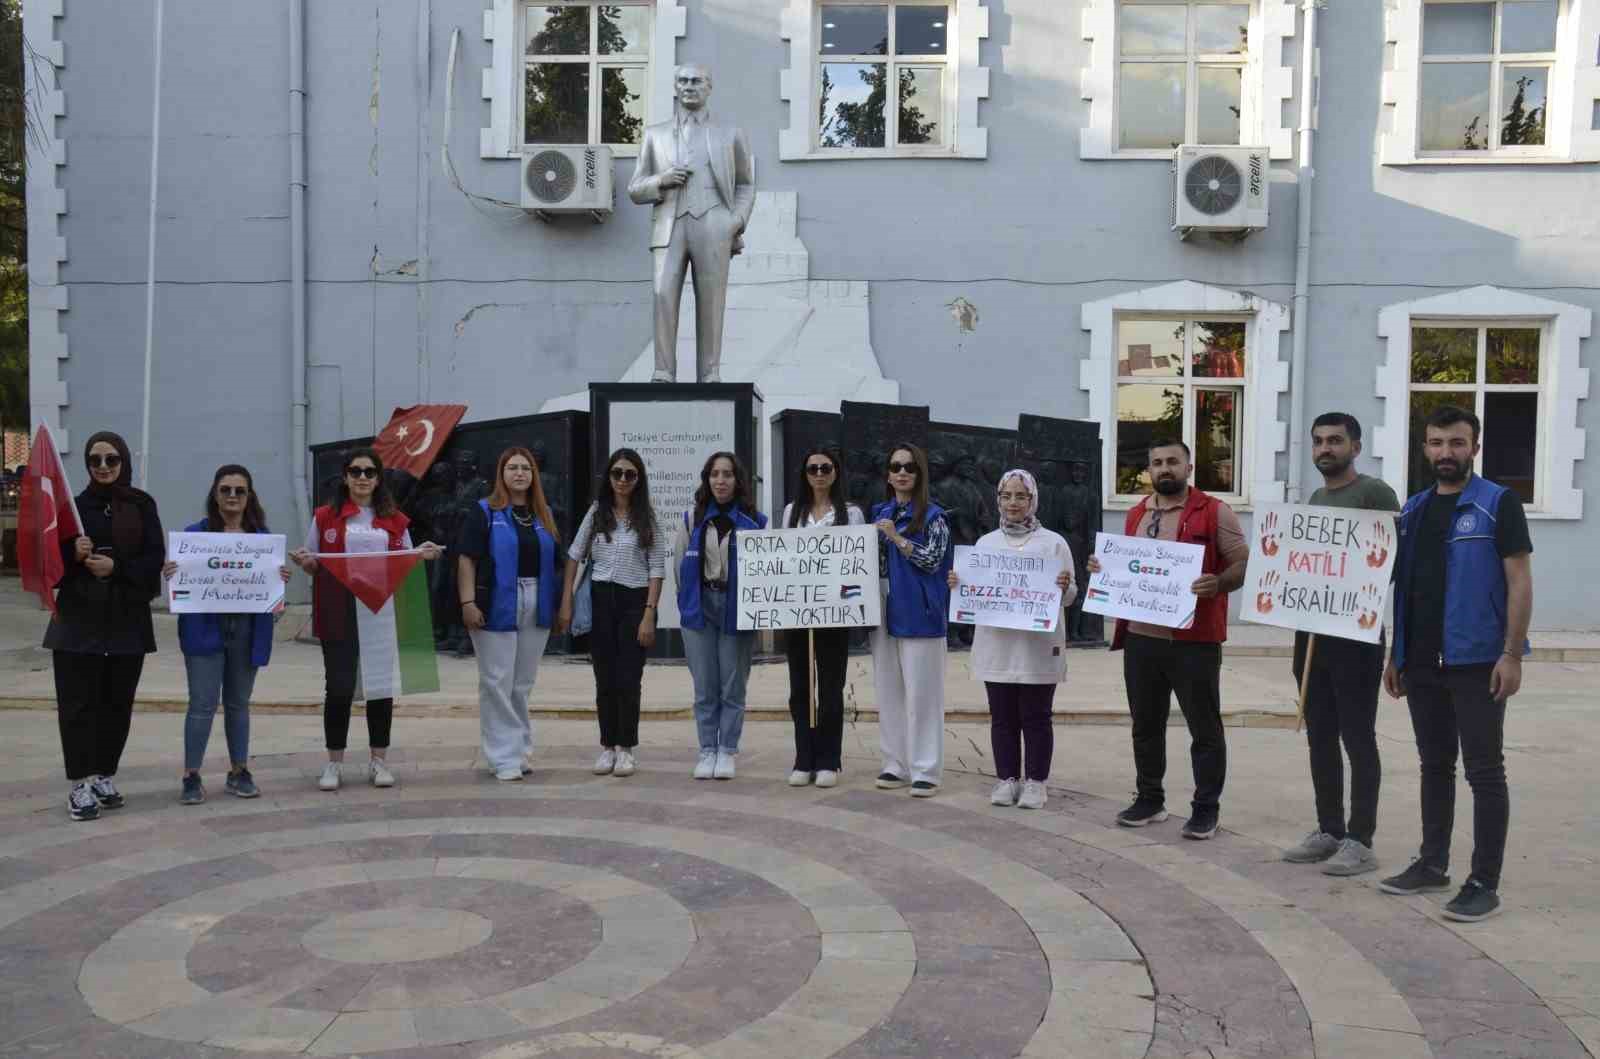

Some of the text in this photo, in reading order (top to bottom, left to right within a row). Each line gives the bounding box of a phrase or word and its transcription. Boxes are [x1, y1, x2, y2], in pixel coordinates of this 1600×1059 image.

[621, 432, 723, 444] Türkiye Cumhuriyeti
[1291, 513, 1361, 549] BEBEK
[744, 536, 787, 554] ORTA
[207, 556, 253, 570] Gazze
[799, 556, 832, 575] DİYE
[840, 556, 868, 576] BİR
[1128, 559, 1170, 576] Gazze
[1288, 551, 1348, 577] KATİLİ
[742, 584, 828, 603] DEVLETE
[1281, 582, 1359, 617] İSRAİL!!!
[745, 604, 866, 630] YER YOKTUR!
